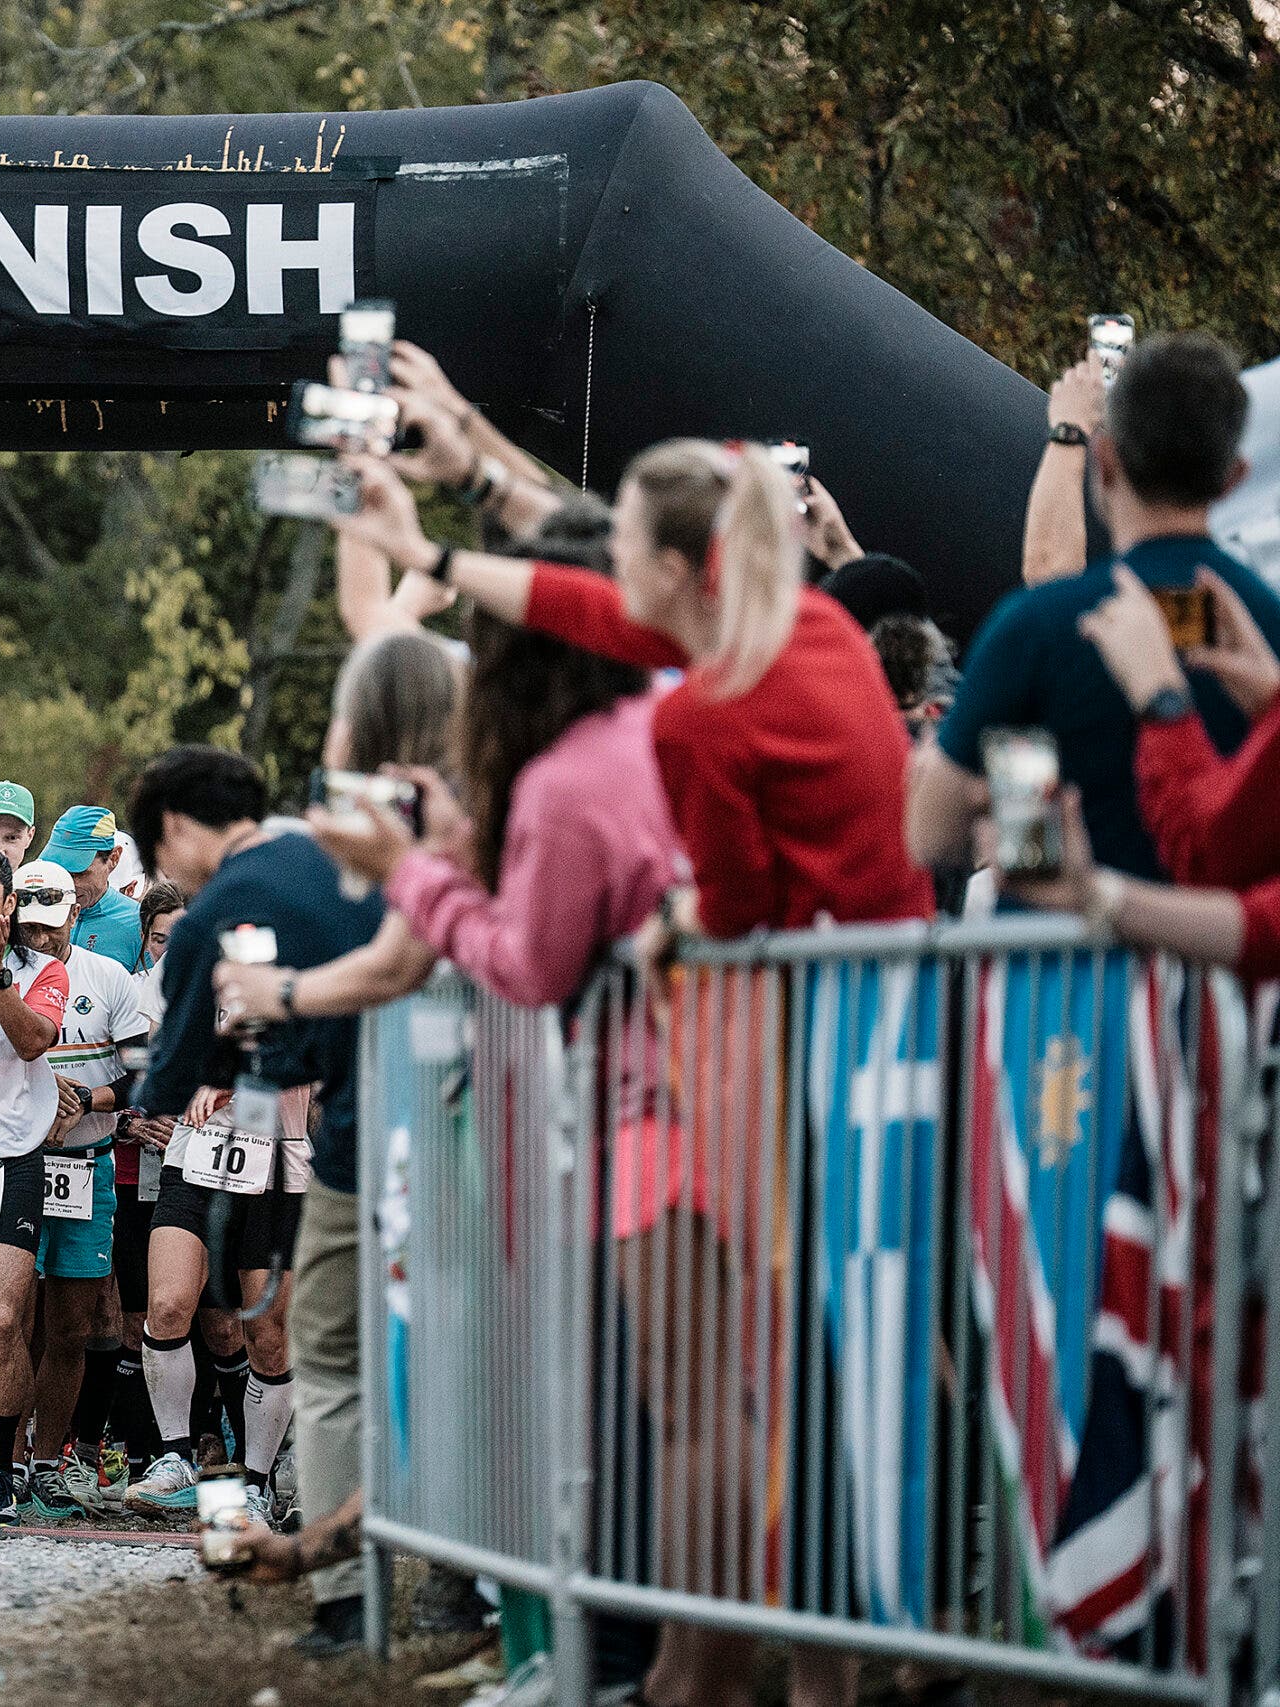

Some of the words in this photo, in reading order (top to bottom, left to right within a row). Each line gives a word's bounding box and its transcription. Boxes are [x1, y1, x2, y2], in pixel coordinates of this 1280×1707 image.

[44, 1161, 71, 1169] ckyard
[211, 1143, 246, 1175] 10
[44, 1172, 70, 1200] 58
